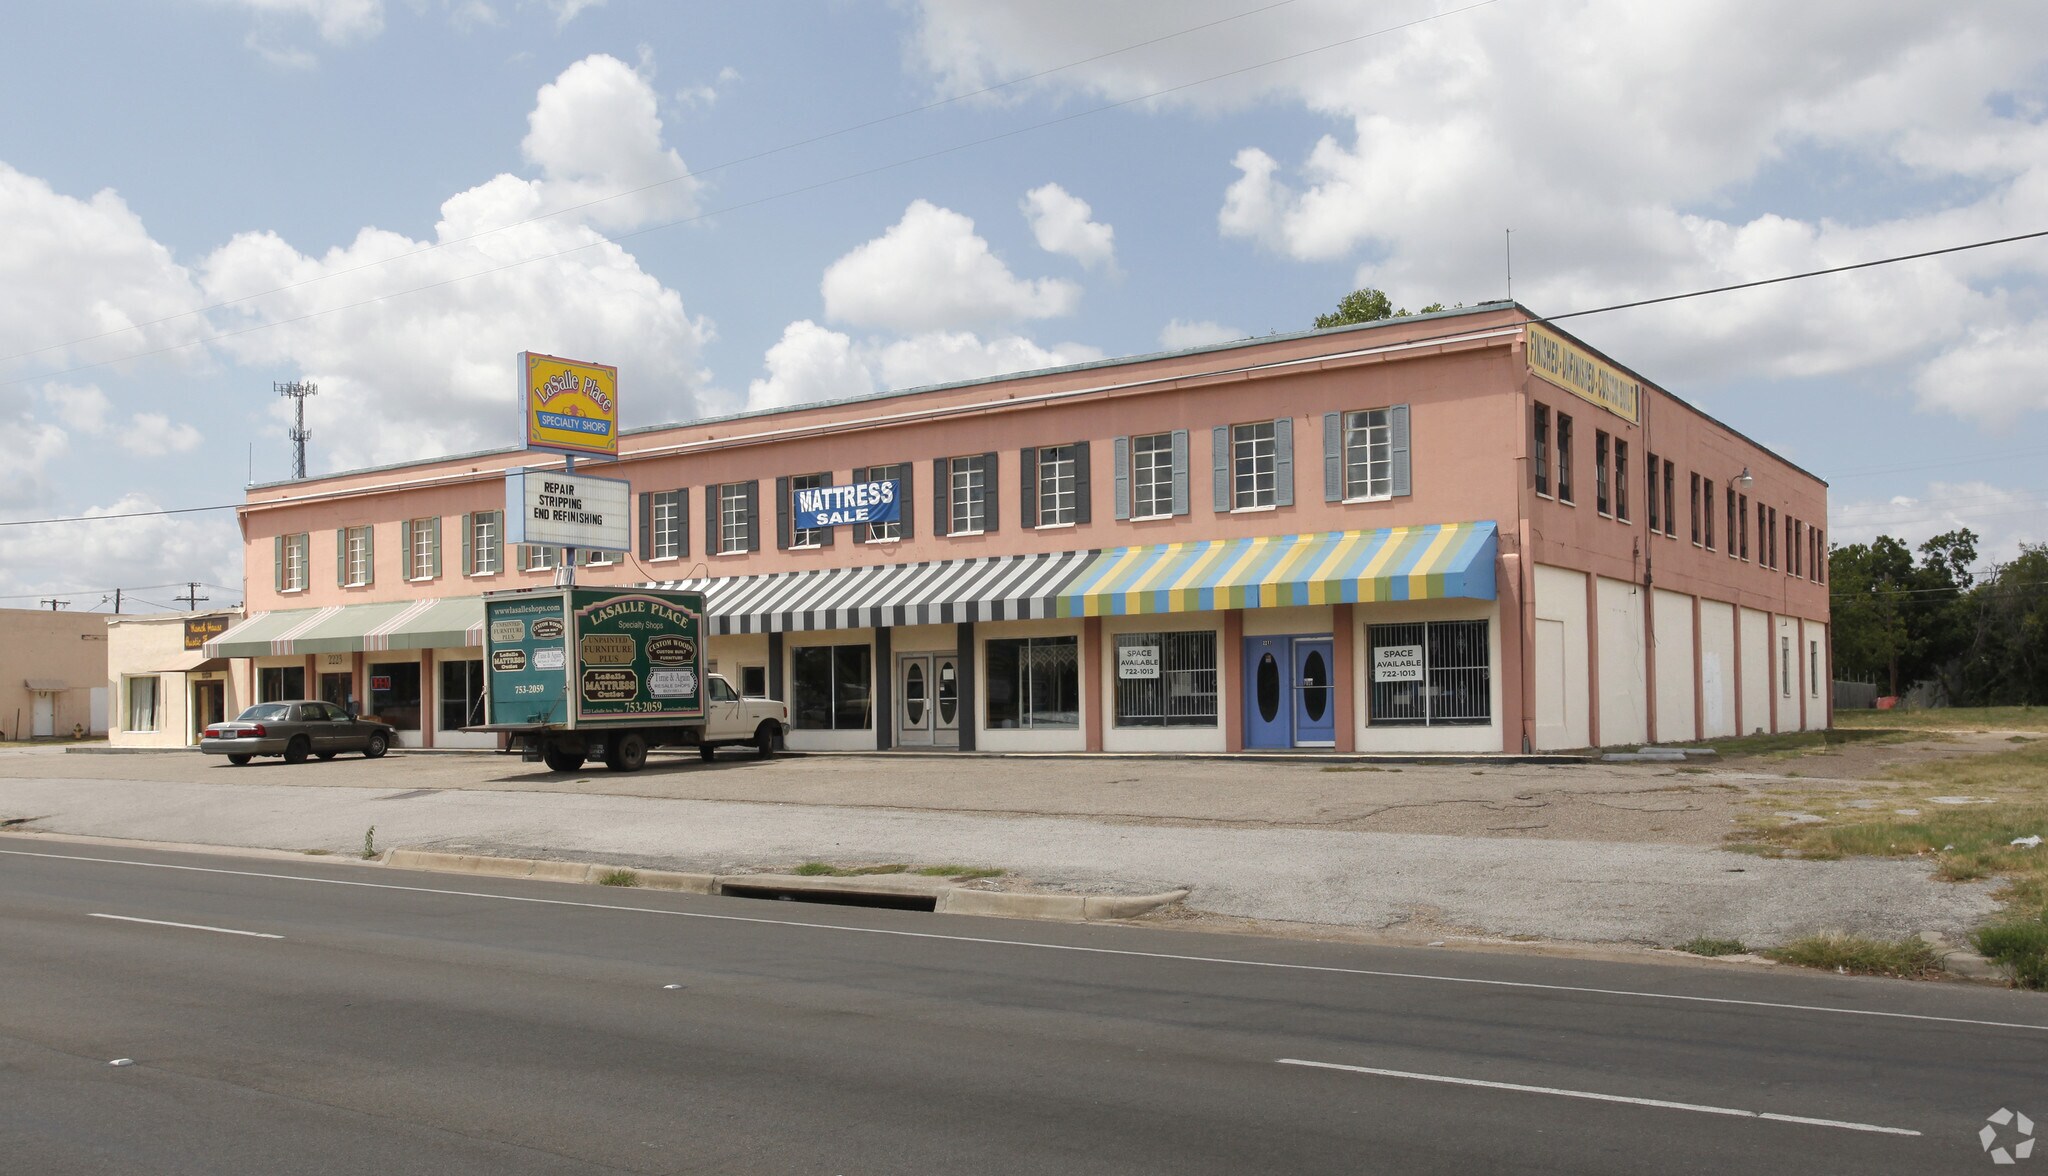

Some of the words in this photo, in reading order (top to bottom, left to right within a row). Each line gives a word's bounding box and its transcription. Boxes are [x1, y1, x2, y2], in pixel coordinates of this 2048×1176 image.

[535, 370, 579, 404] LaSalle
[582, 376, 612, 412] Place
[542, 415, 580, 429] SPECIALTY
[582, 421, 607, 433] SHOPS
[544, 481, 575, 496] REPAIR
[539, 494, 582, 510] STRIPPING
[799, 481, 894, 513] MATTRESS
[534, 507, 550, 520] END
[553, 509, 603, 525] REFINISHING
[816, 508, 869, 526] SALE
[590, 601, 646, 626] LASALLE
[650, 603, 689, 629] PLACE
[618, 620, 645, 630] Specialty
[645, 621, 664, 630] Shops
[648, 640, 672, 652] CUSTOM
[673, 640, 693, 652] WOODS
[1384, 650, 1414, 658] SPACE
[494, 656, 525, 665] MATTRESS
[1377, 660, 1422, 668] AVAILABLE
[655, 673, 669, 682] Time
[669, 673, 674, 682] &
[675, 673, 690, 683] Again
[1382, 669, 1416, 678] 722-1013
[515, 684, 545, 694] 753-2059
[585, 681, 636, 691] MATTRESS
[624, 701, 663, 713] 753-2059
